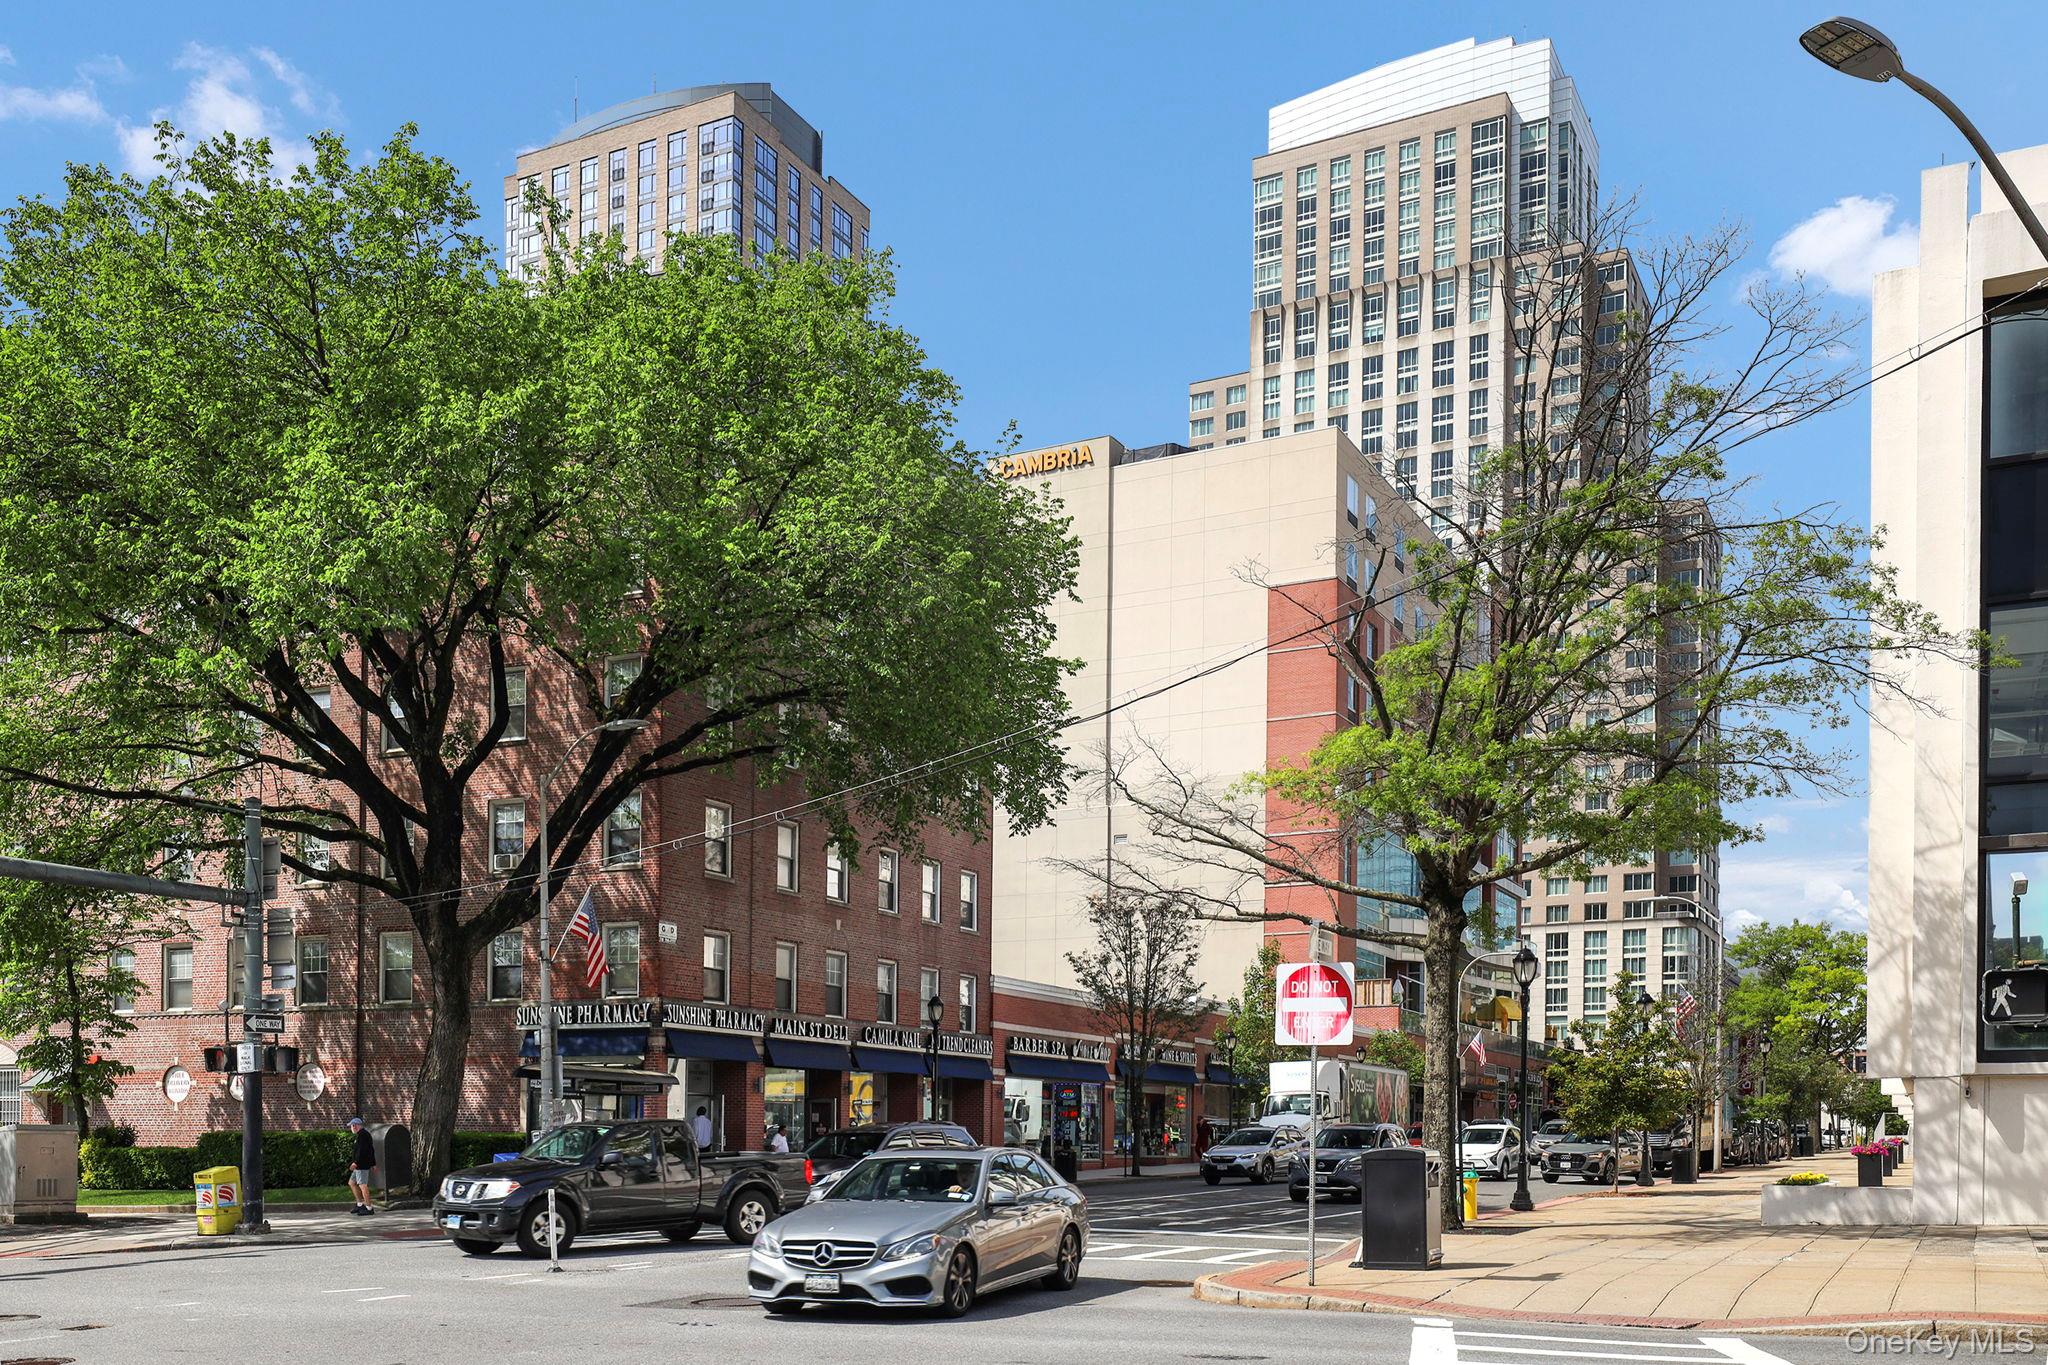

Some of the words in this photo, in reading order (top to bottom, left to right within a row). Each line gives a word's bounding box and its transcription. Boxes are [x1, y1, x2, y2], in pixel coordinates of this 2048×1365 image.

[1291, 980, 1308, 993] DO
[1314, 980, 1339, 993] NOT
[577, 1002, 651, 1024] PHARMACY
[666, 1003, 713, 1027] SUNSHINE
[715, 1009, 766, 1032] PHARMACY
[1294, 1017, 1334, 1029] ENER
[255, 1020, 268, 1028] ONE
[268, 1020, 281, 1028] WAY
[775, 1017, 807, 1037] MAIN
[809, 1022, 823, 1039] ST
[824, 1023, 849, 1041] DELI
[865, 1026, 899, 1047] CAMILA
[901, 1031, 922, 1049] NAIL
[942, 1035, 963, 1052] TREND
[963, 1037, 993, 1055] CLEANERS
[1013, 1036, 1048, 1054] BARBER
[1051, 1039, 1067, 1056] SPA
[1179, 1050, 1197, 1064] SPIRITS
